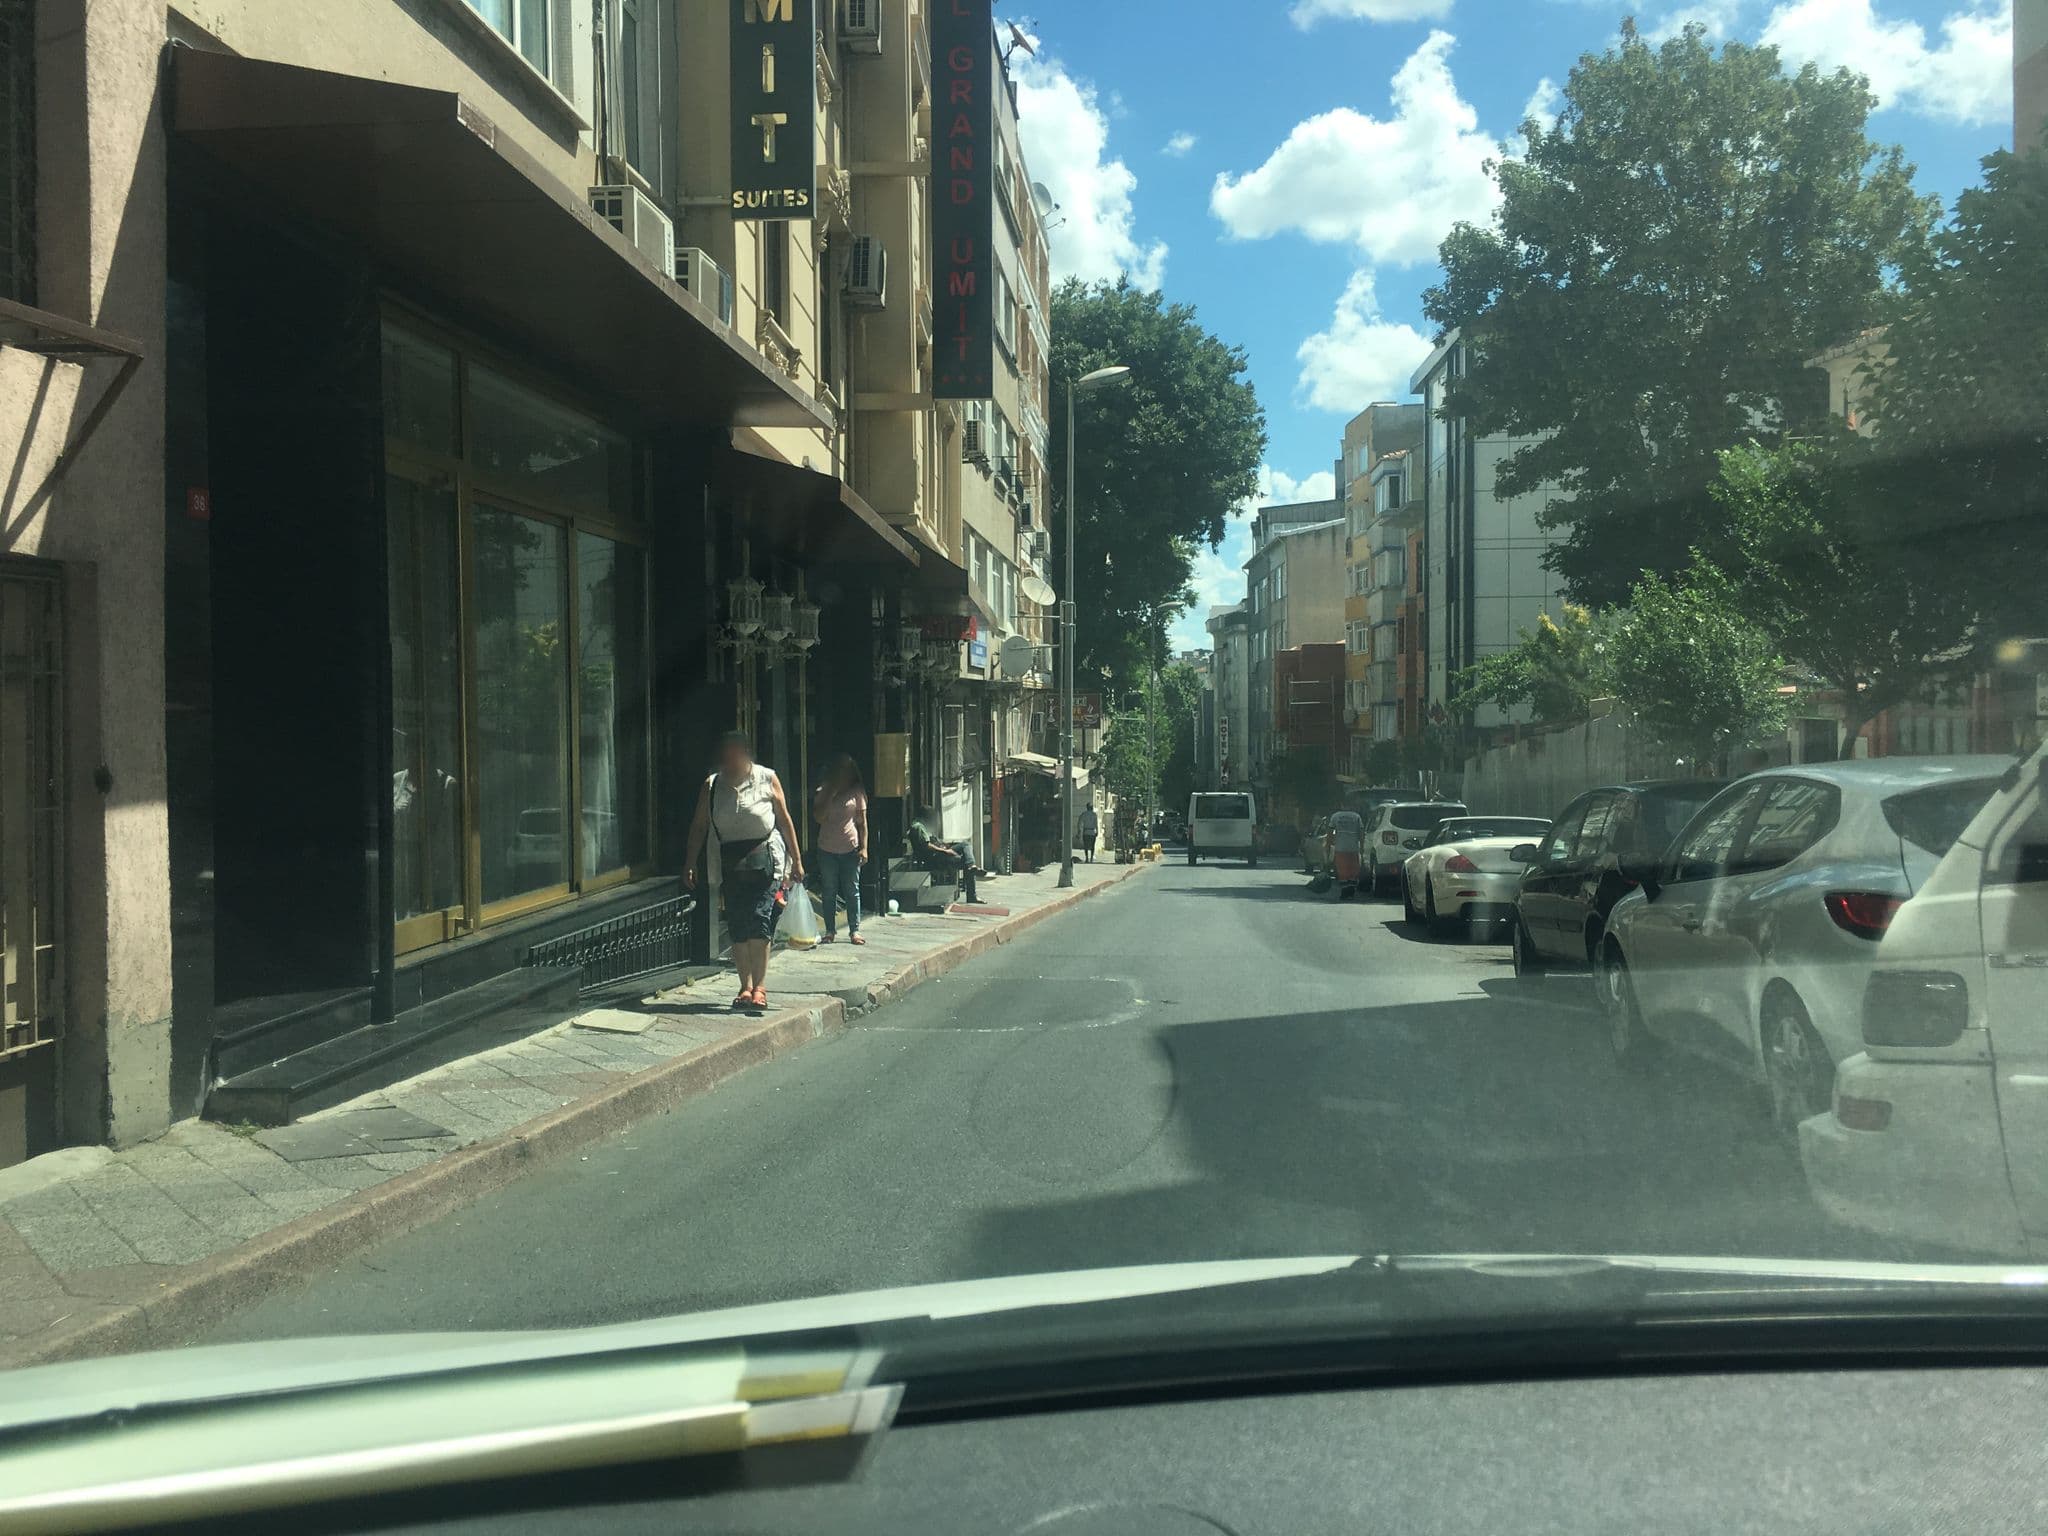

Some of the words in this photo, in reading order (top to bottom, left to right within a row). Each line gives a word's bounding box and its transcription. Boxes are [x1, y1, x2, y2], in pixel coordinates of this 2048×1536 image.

[948, 46, 975, 205] GRAND
[732, 189, 809, 208] SUITES
[1220, 718, 1228, 756] HOTEL
